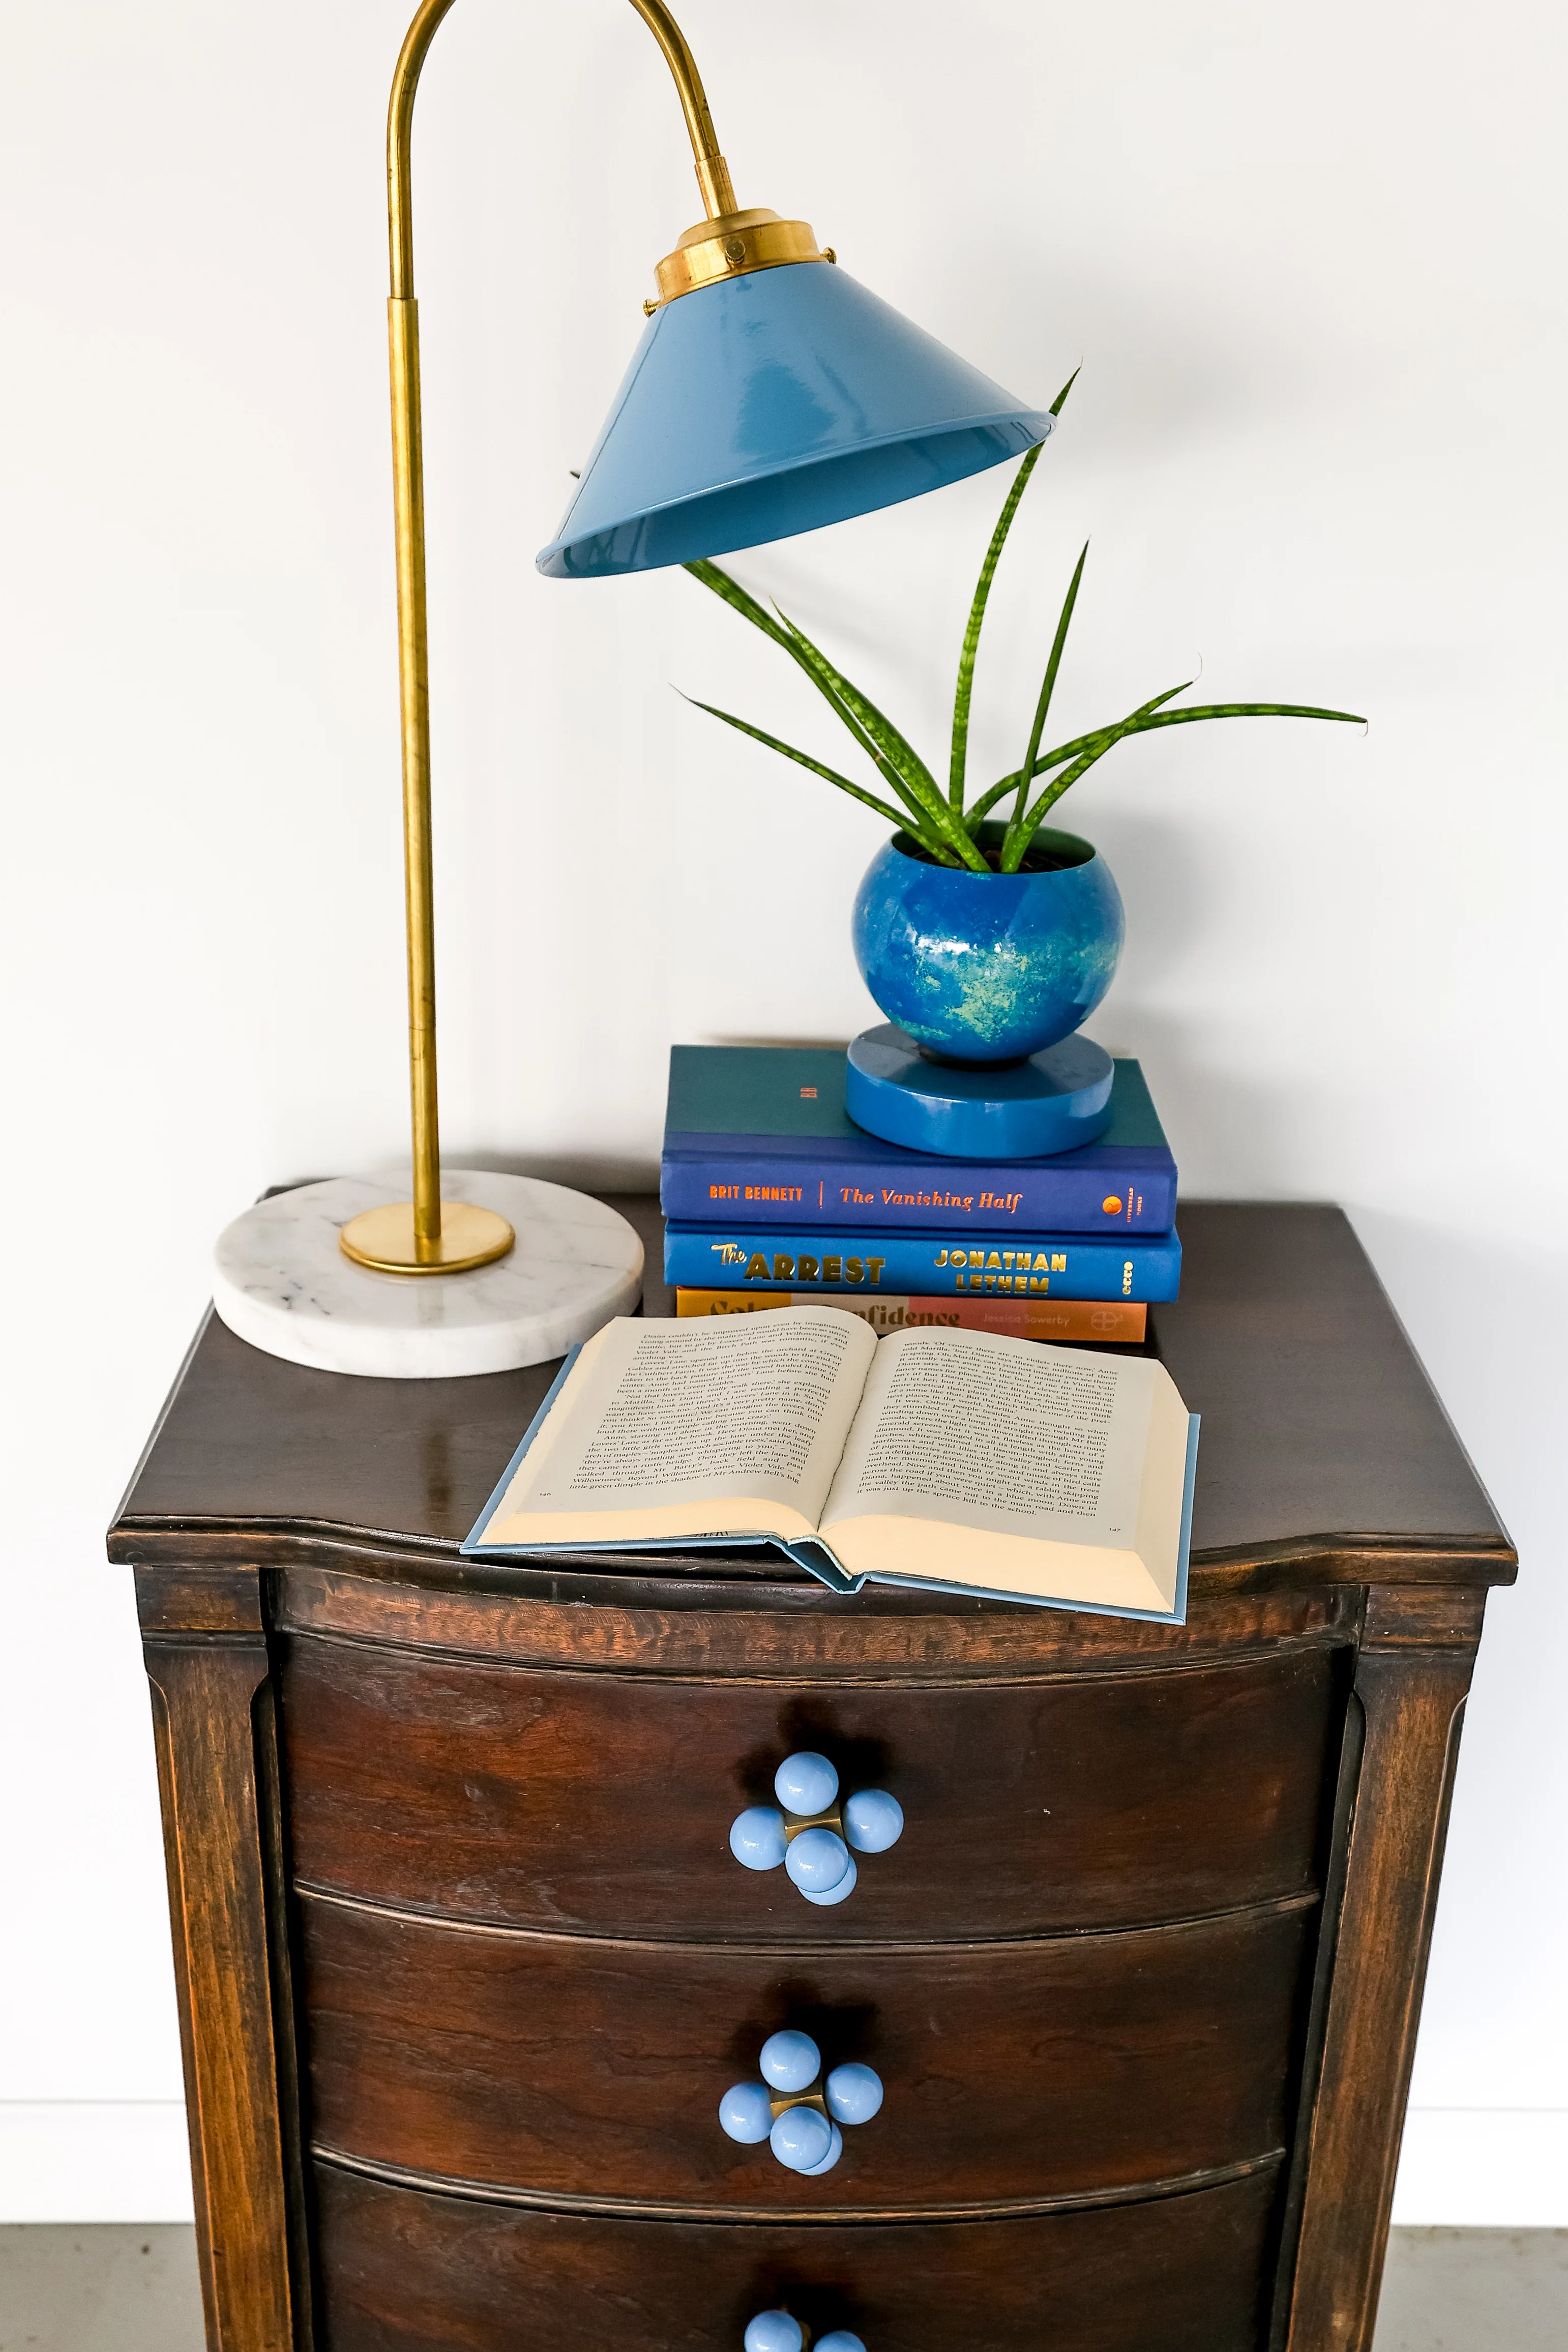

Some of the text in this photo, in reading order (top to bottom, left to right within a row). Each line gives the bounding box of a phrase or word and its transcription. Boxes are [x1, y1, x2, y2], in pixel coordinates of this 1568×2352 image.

[710, 1185, 802, 1201] BRIT BENNETT
[840, 1188, 1023, 1214] The Vanishing Half
[711, 1242, 885, 1285] The ARREST
[934, 1249, 1067, 1272] JONATHAN
[956, 1274, 1049, 1294] LETHEM
[984, 1314, 1070, 1327] Jessica Sowerby
[1036, 1403, 1071, 1413] Anybody
[800, 1432, 814, 1440] and
[786, 1461, 804, 1471] past
[791, 1456, 806, 1464] and
[662, 1467, 710, 1477] Willowmere
[959, 1464, 982, 1473] laugh
[787, 1474, 800, 1484] big
[891, 1474, 932, 1482] happened
[935, 1479, 959, 1487] about
[1059, 1502, 1084, 1510] Down
[986, 1477, 1010, 1485] might
[1063, 1490, 1099, 1500] skipping
[1007, 1488, 1033, 1496] which,
[932, 1492, 960, 1500] spruce
[1007, 1507, 1037, 1515] school.
